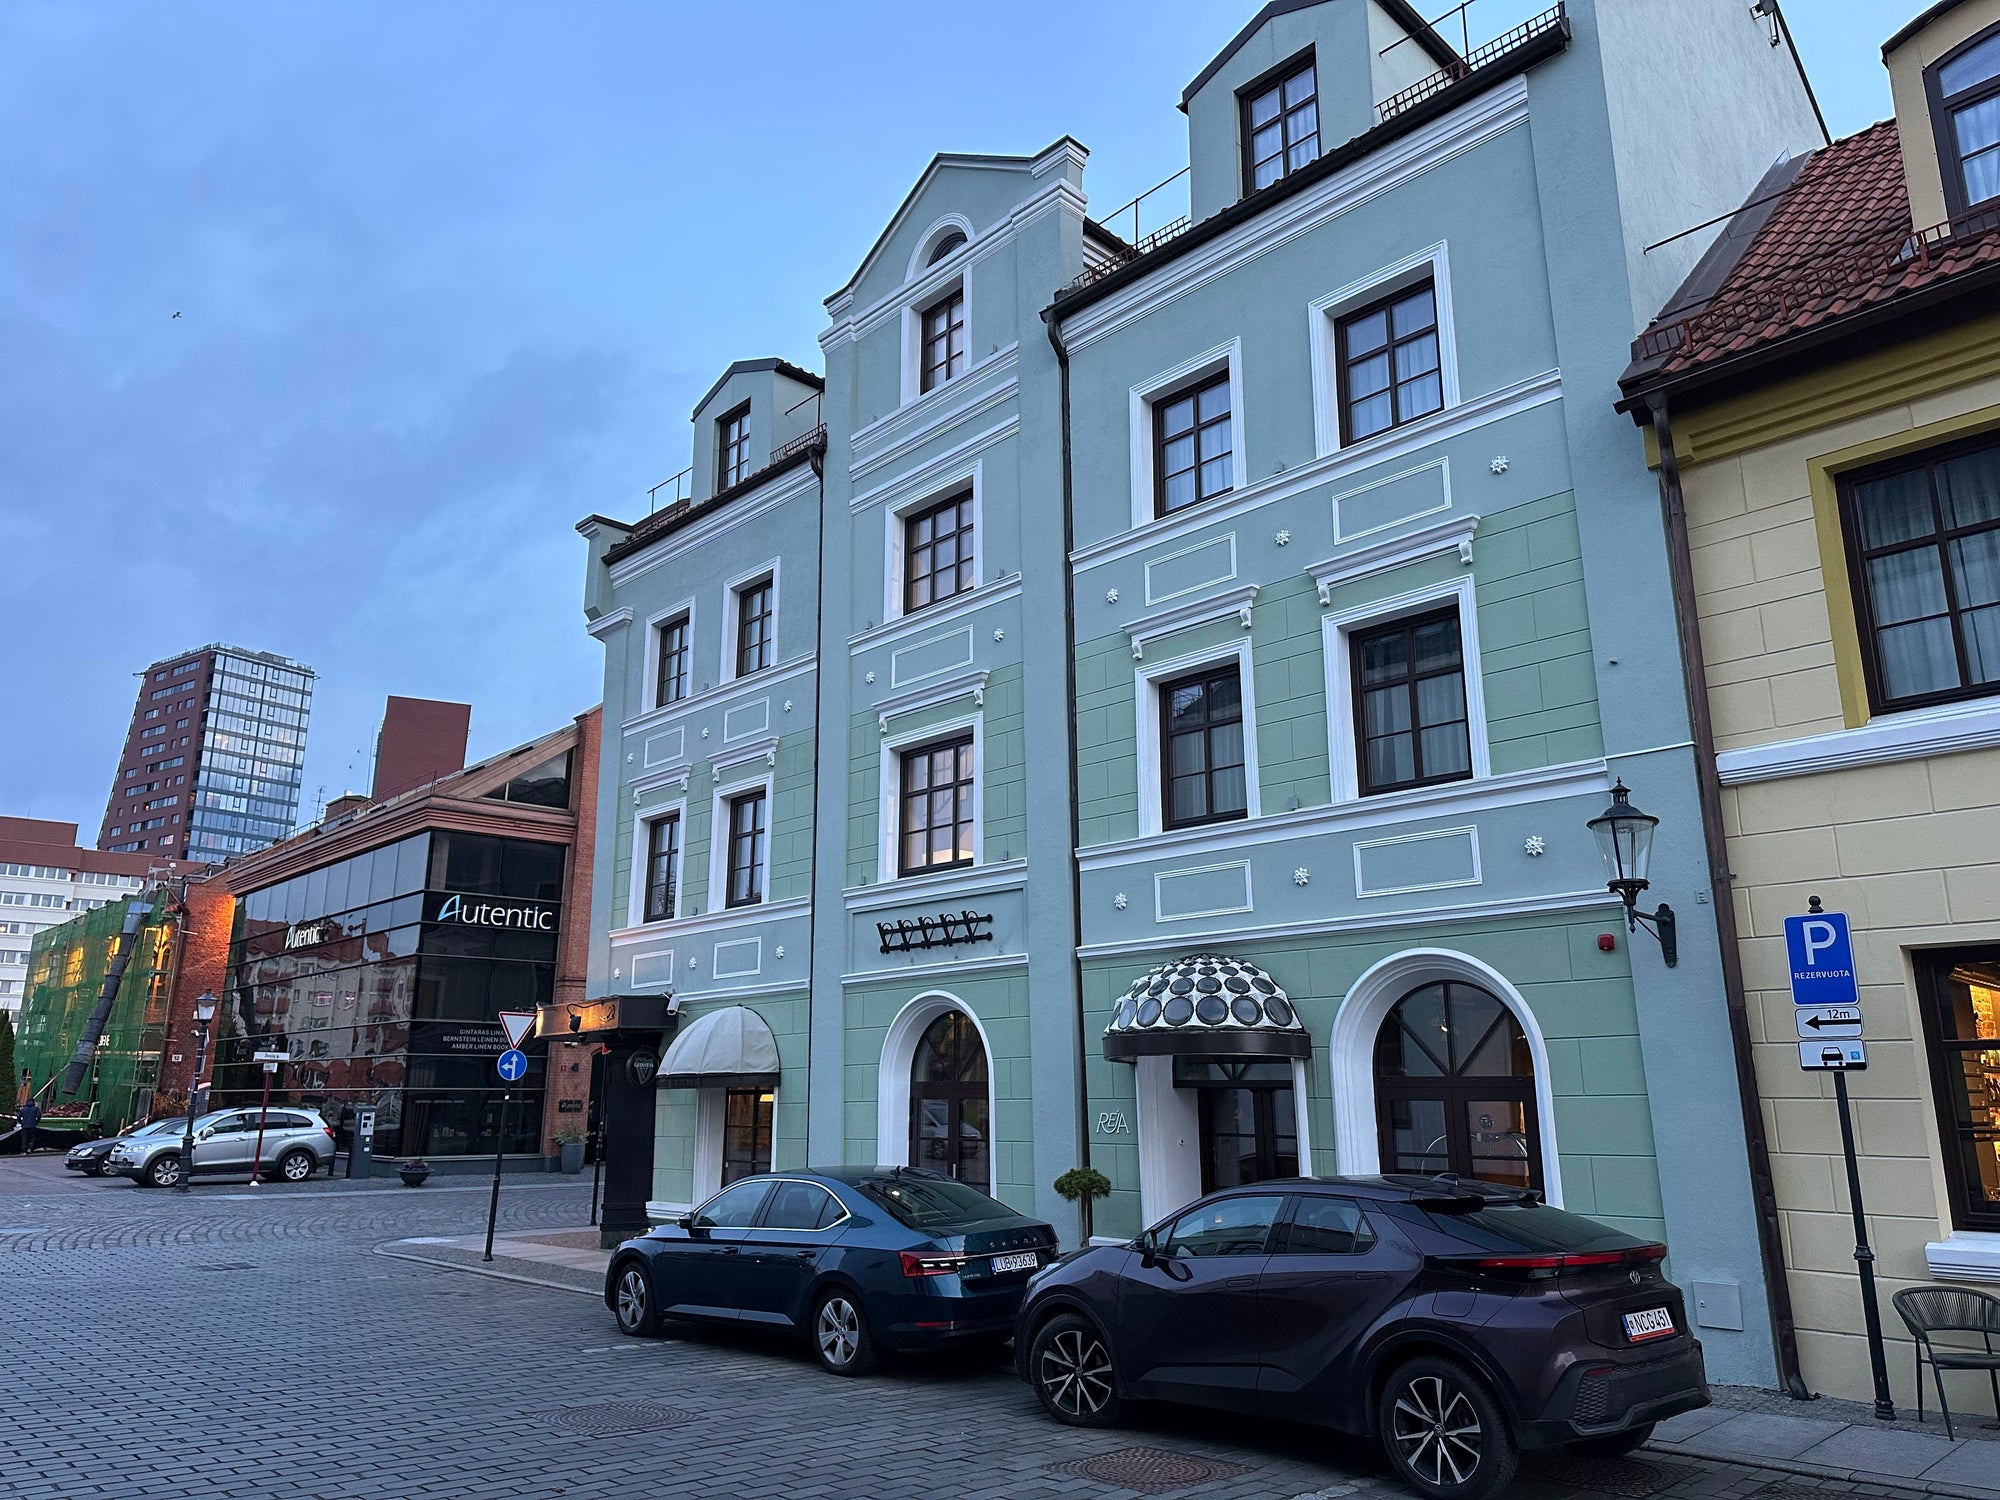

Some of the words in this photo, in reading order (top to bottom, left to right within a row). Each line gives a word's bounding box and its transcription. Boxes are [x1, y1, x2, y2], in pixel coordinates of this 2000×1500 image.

[437, 894, 553, 930] Autentic
[285, 924, 321, 950] Autentic
[1802, 920, 1837, 965] P
[1794, 969, 1850, 980] REZERVUOTA
[1827, 1009, 1850, 1019] 12m
